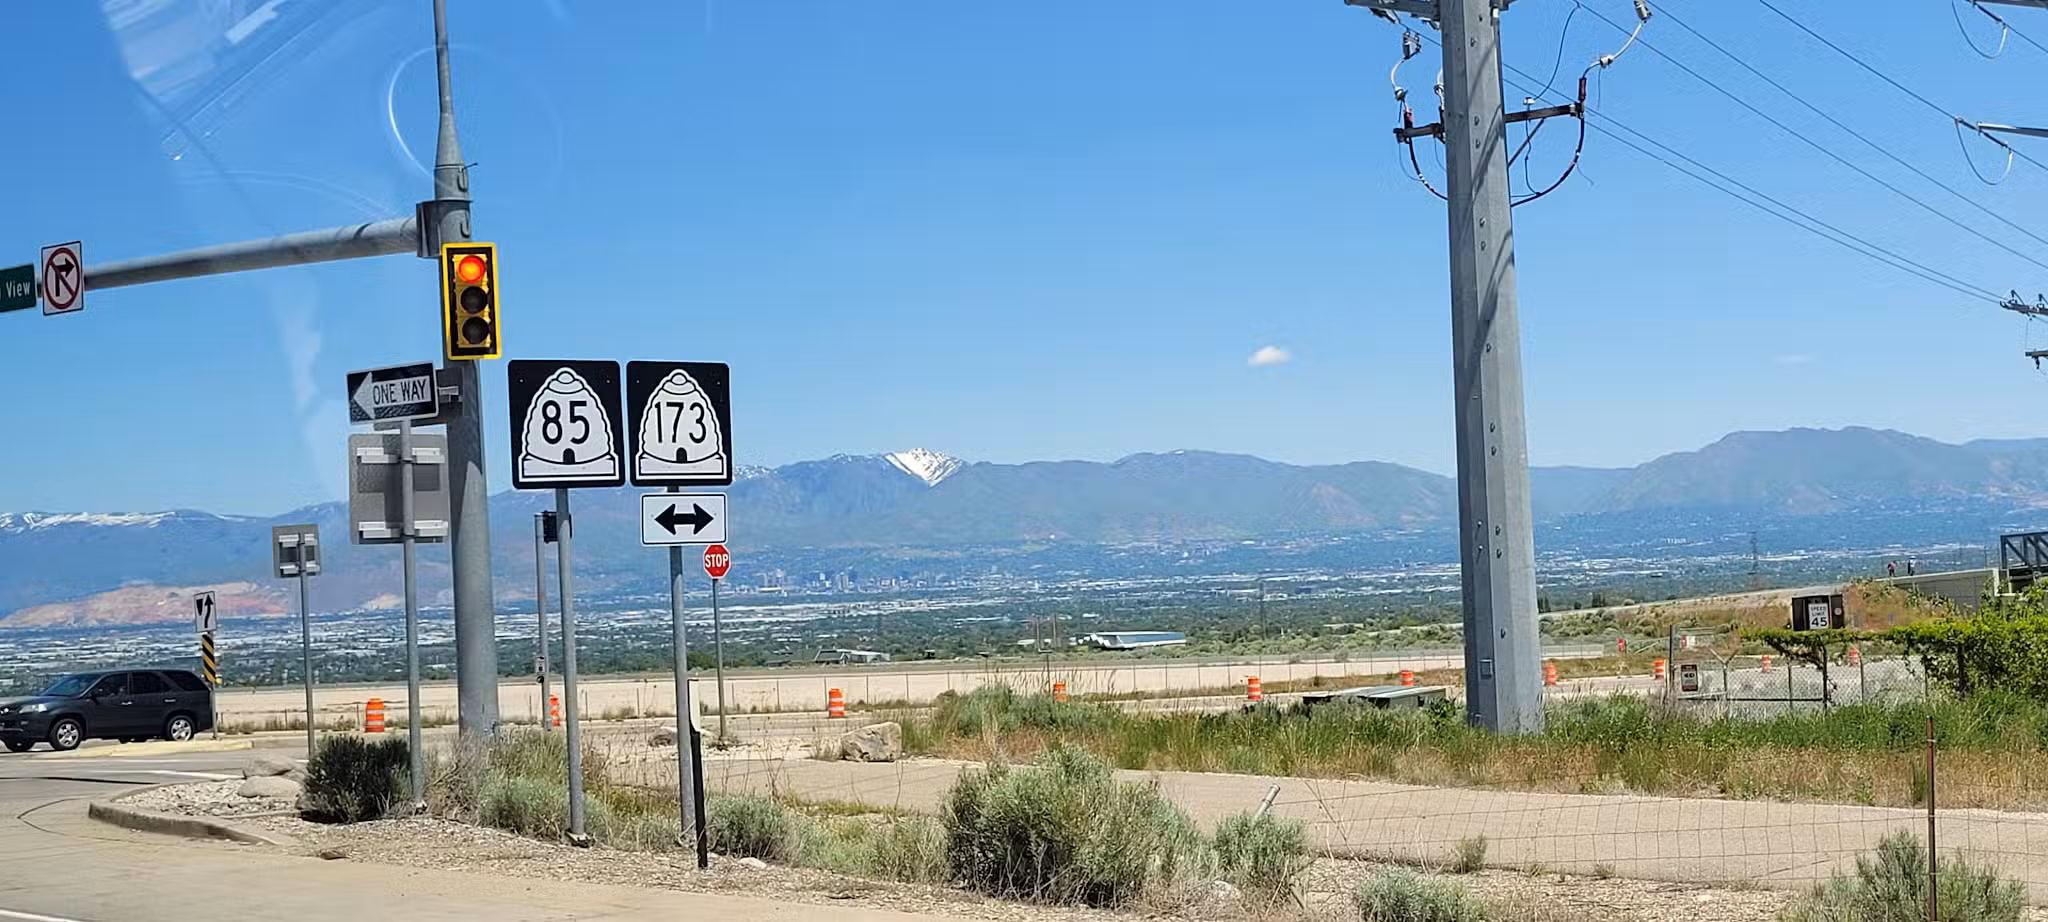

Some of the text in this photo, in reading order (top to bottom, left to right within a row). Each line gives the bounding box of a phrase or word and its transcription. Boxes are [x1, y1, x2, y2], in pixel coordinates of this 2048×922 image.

[5, 280, 31, 299] View
[373, 379, 427, 405] ONE WAY
[541, 400, 590, 444] 85
[654, 401, 707, 444] 173
[705, 553, 729, 568] STOP
[1811, 617, 1827, 626] 45
